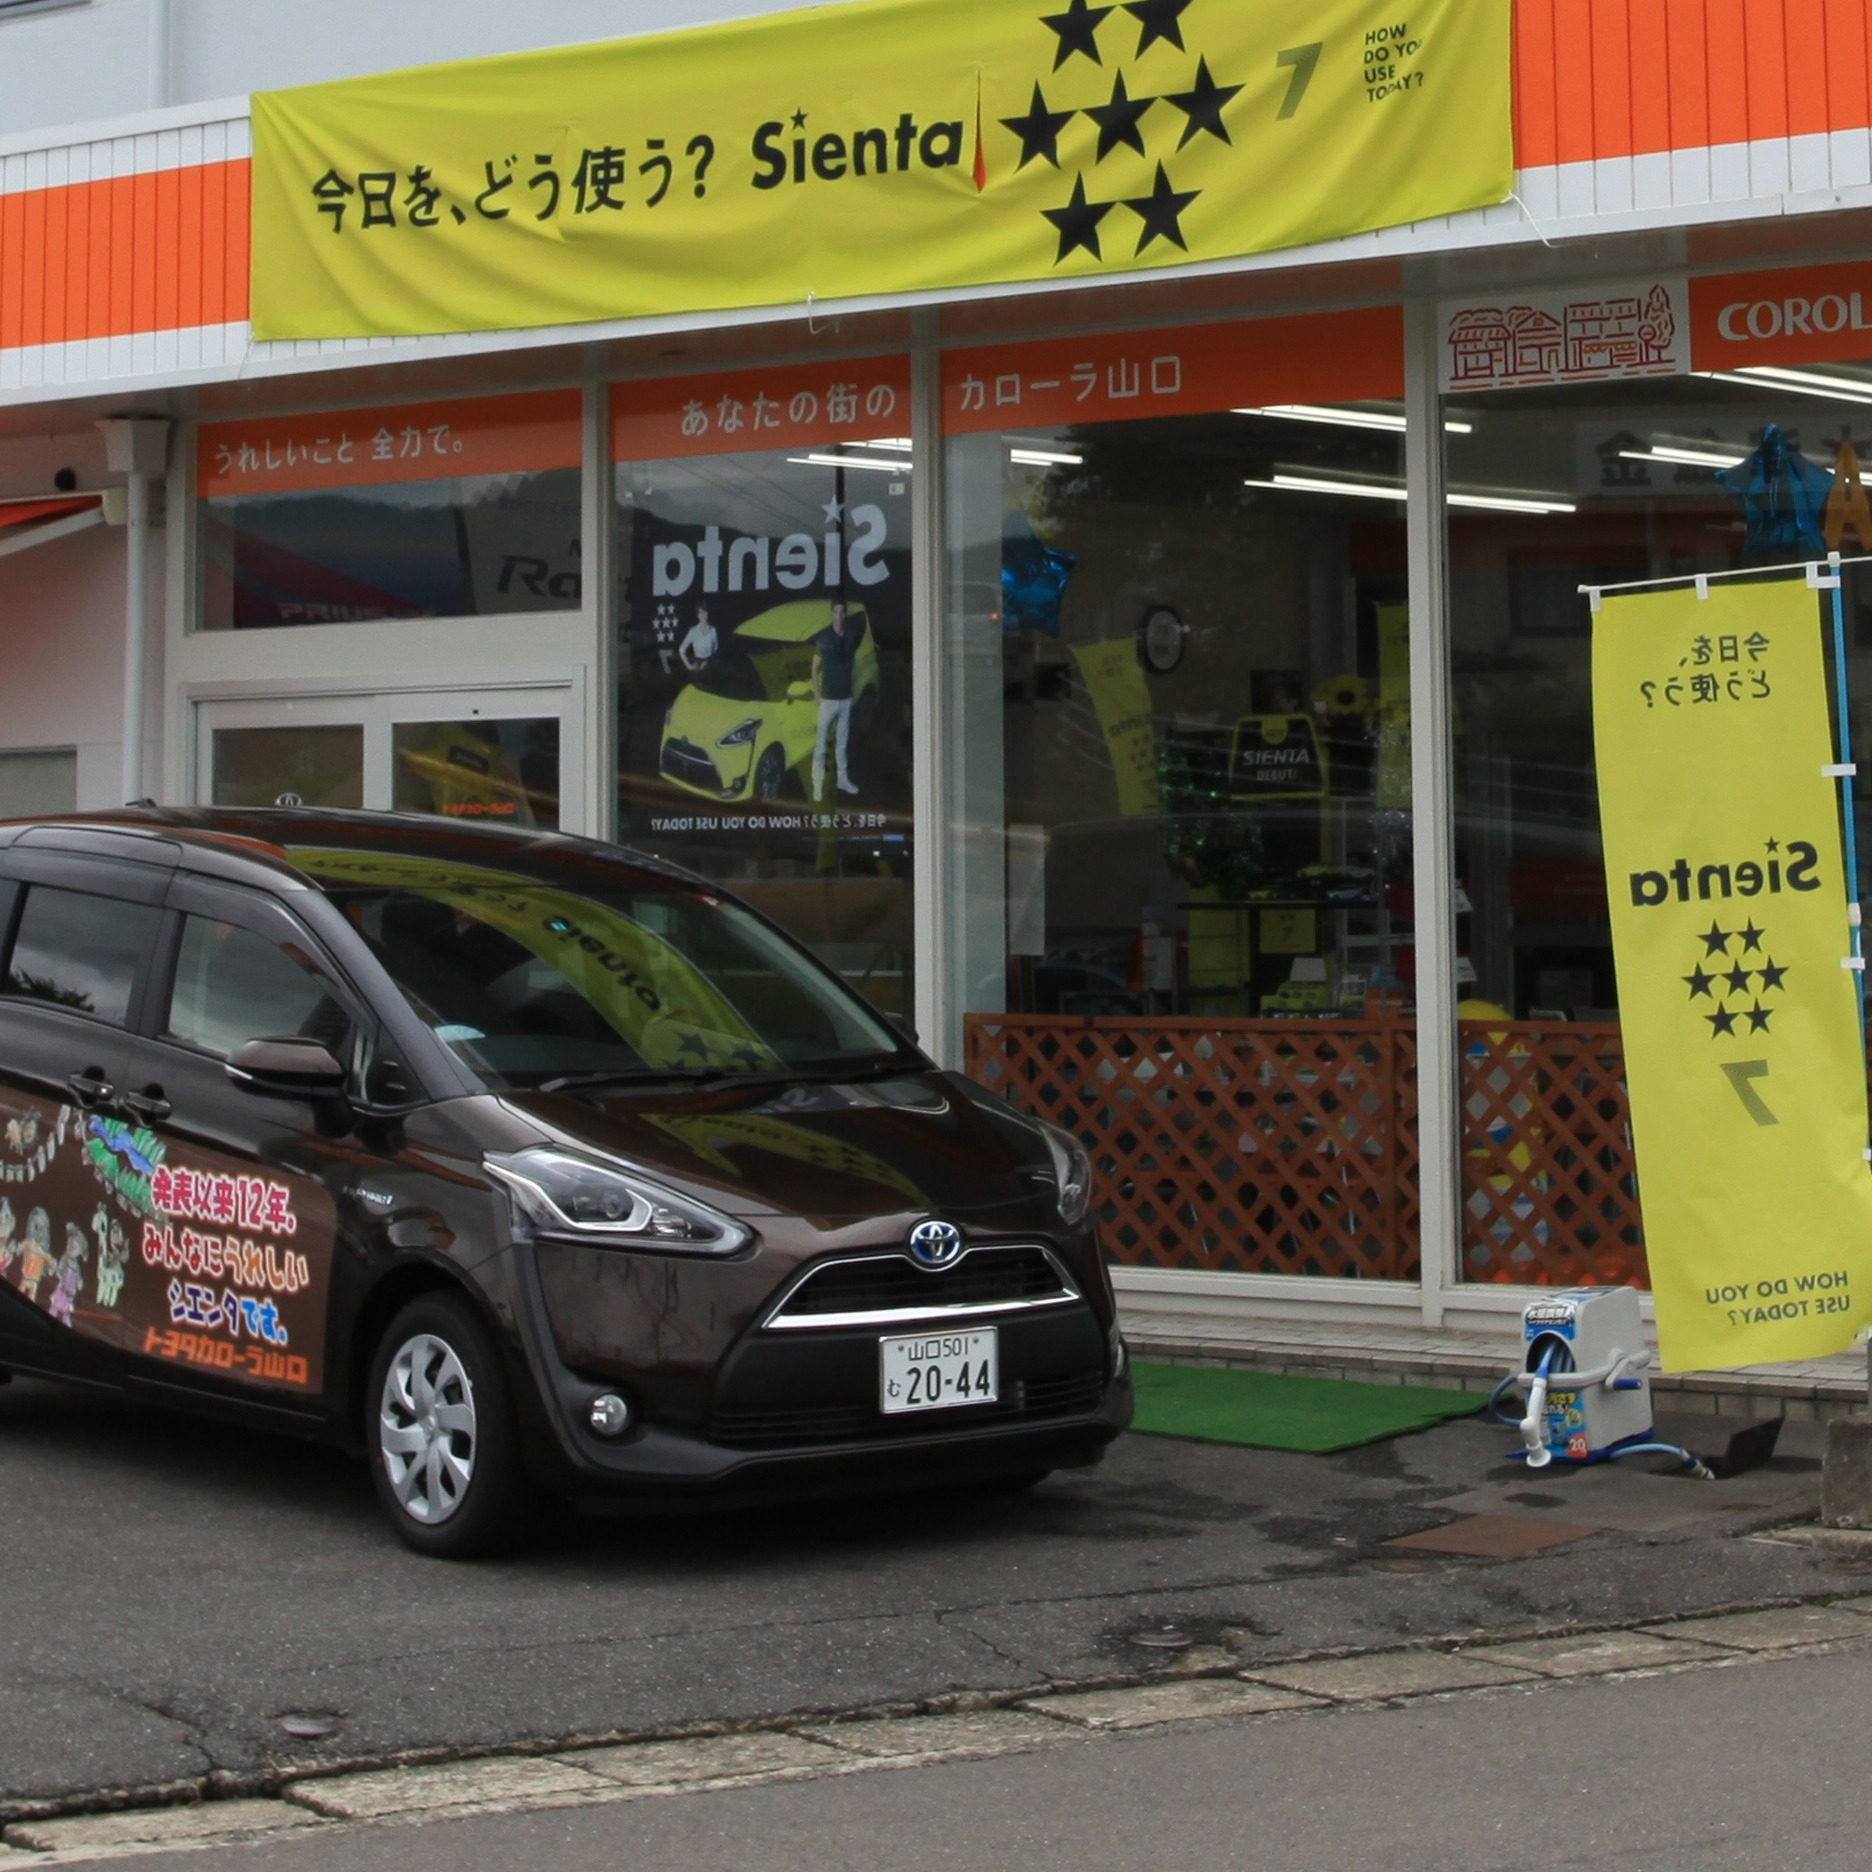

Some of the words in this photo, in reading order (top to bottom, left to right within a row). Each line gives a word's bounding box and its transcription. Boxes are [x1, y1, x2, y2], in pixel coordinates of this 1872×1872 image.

[1363, 46, 1390, 64] DO
[1394, 39, 1423, 58] YO
[1364, 23, 1407, 46] HOW
[1275, 41, 1323, 121] 7
[1363, 64, 1396, 84] USE
[311, 134, 715, 233] 今日を、どう使う?
[750, 107, 964, 190] Sienta
[680, 383, 897, 437] あなたの街の
[960, 355, 1182, 411] カローラ山口
[215, 432, 354, 475] うれしいこと
[371, 424, 464, 460] 全力で。
[1242, 748, 1311, 766] SIENTA
[150, 1163, 297, 1234] 発表以来12年。
[142, 1222, 310, 1292] みんなにうれしい
[168, 1278, 289, 1345] シエンタです。
[142, 1326, 308, 1385] トヨタカローラ山口
[906, 1359, 990, 1405] 20-44
[1569, 1438, 1587, 1451] 20
